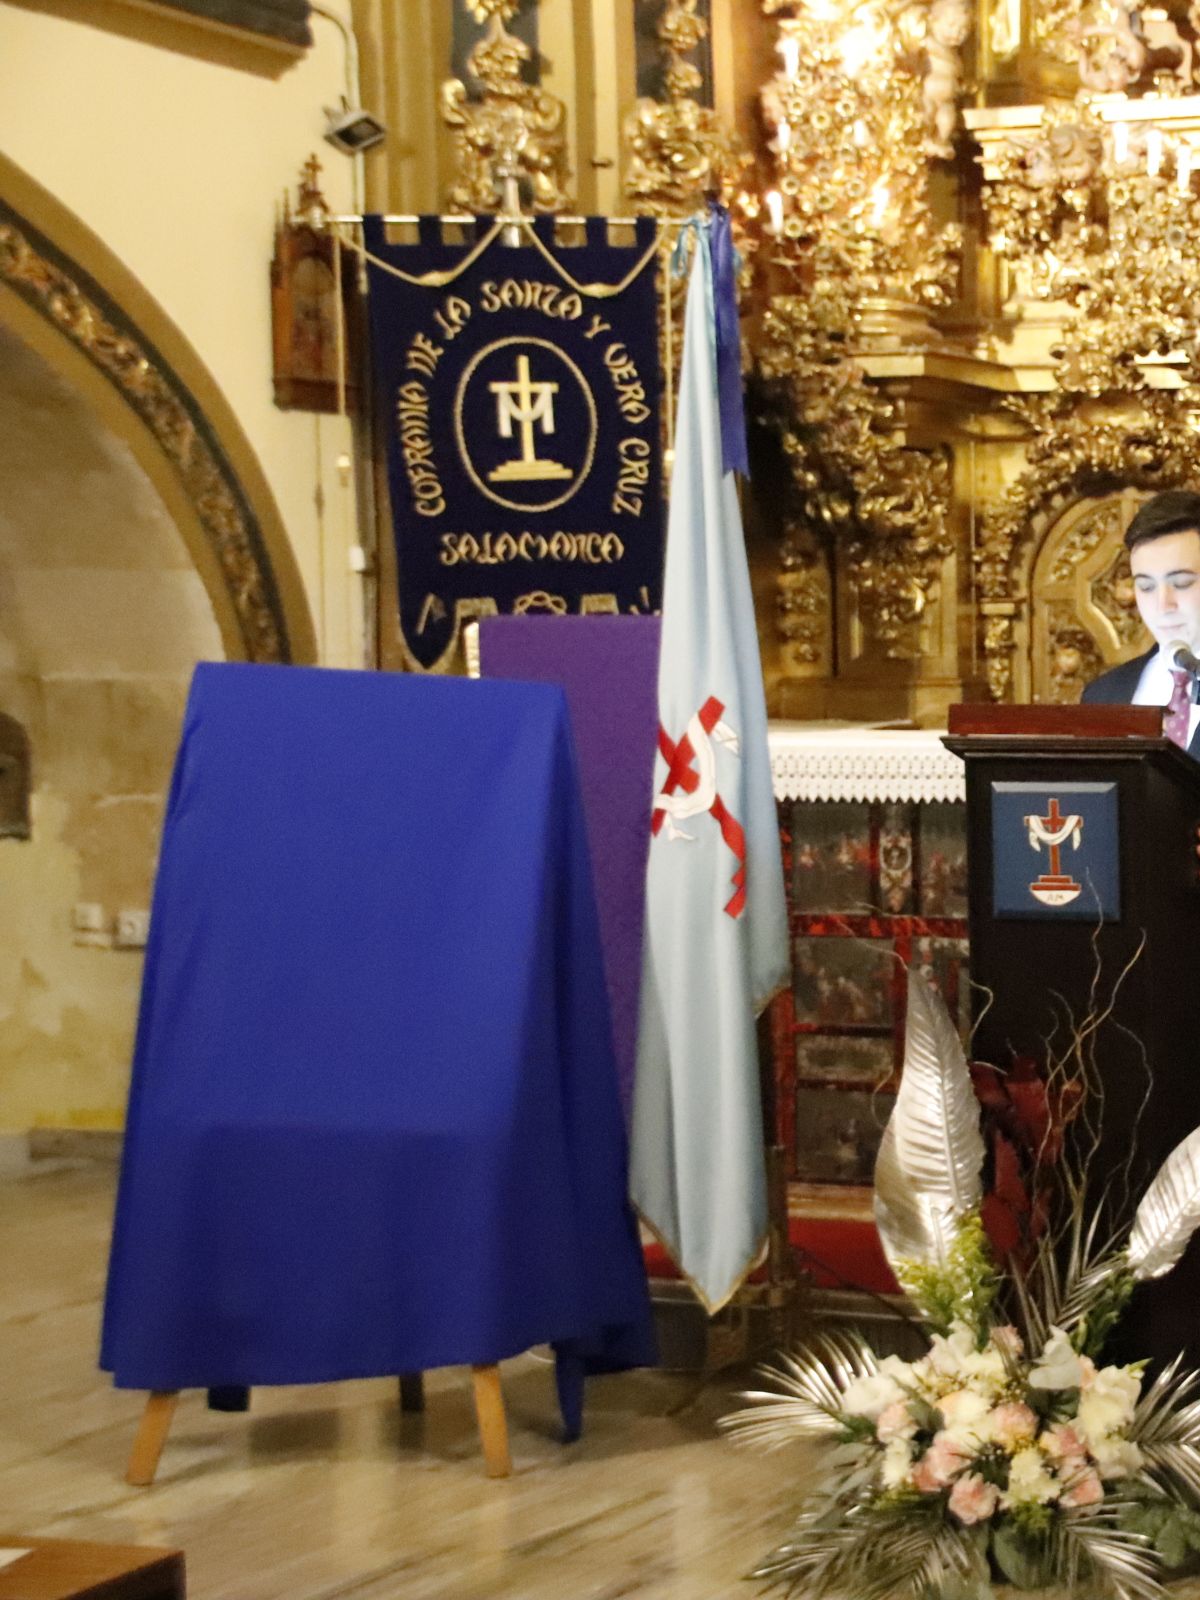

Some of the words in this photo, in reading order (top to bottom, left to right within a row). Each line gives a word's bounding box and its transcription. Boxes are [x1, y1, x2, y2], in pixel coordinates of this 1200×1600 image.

[433, 296, 472, 340] LA
[480, 278, 583, 321] SANTA
[579, 314, 611, 340] Y
[405, 332, 444, 377] DE
[603, 343, 651, 425] VERA
[611, 436, 651, 517] CRUZ
[441, 531, 625, 565] SALAMANCA
